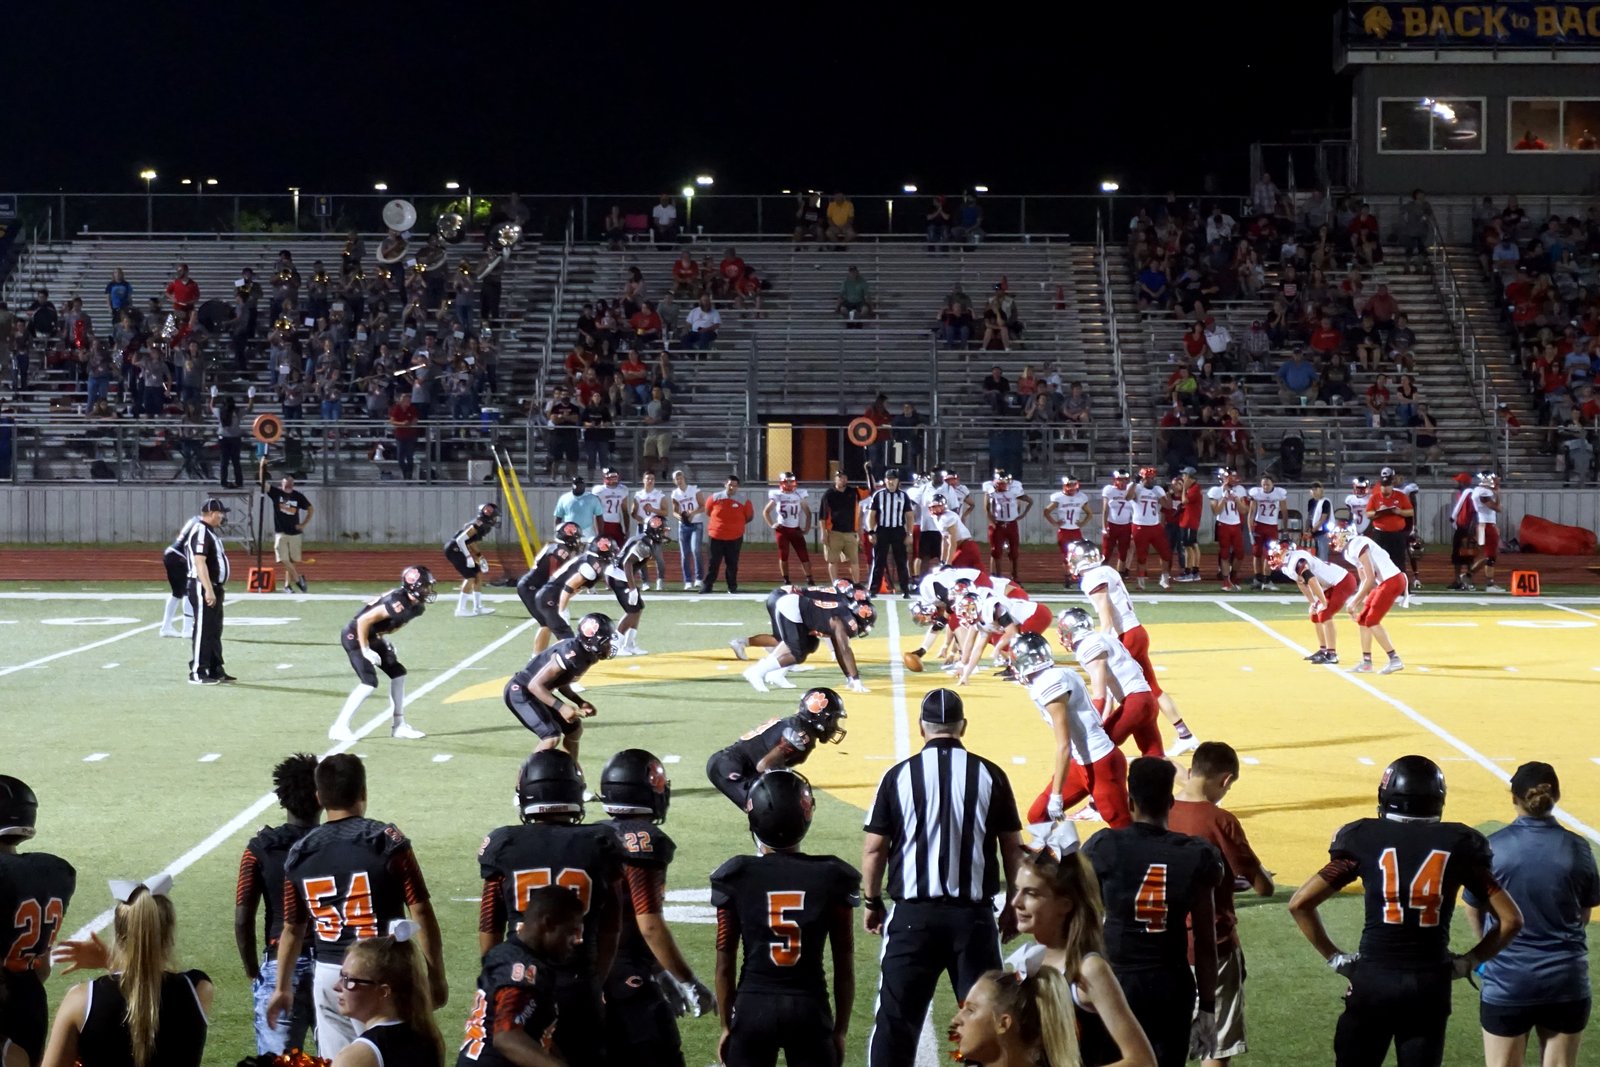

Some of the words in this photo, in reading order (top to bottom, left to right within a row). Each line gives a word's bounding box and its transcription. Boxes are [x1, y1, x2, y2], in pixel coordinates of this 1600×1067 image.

[1403, 6, 1509, 37] BACK
[1511, 12, 1530, 29] to
[893, 442, 903, 464] 1
[780, 504, 799, 519] 54
[1066, 509, 1075, 525] 4
[1117, 501, 1126, 516] 7
[1141, 500, 1157, 517] 75
[1259, 503, 1277, 517] 22
[250, 570, 271, 590] 20
[1517, 574, 1538, 593] 40
[624, 831, 653, 853] 22
[1379, 847, 1451, 928] 14
[303, 871, 379, 942] 54
[1134, 864, 1169, 933] 4
[767, 890, 806, 967] 5
